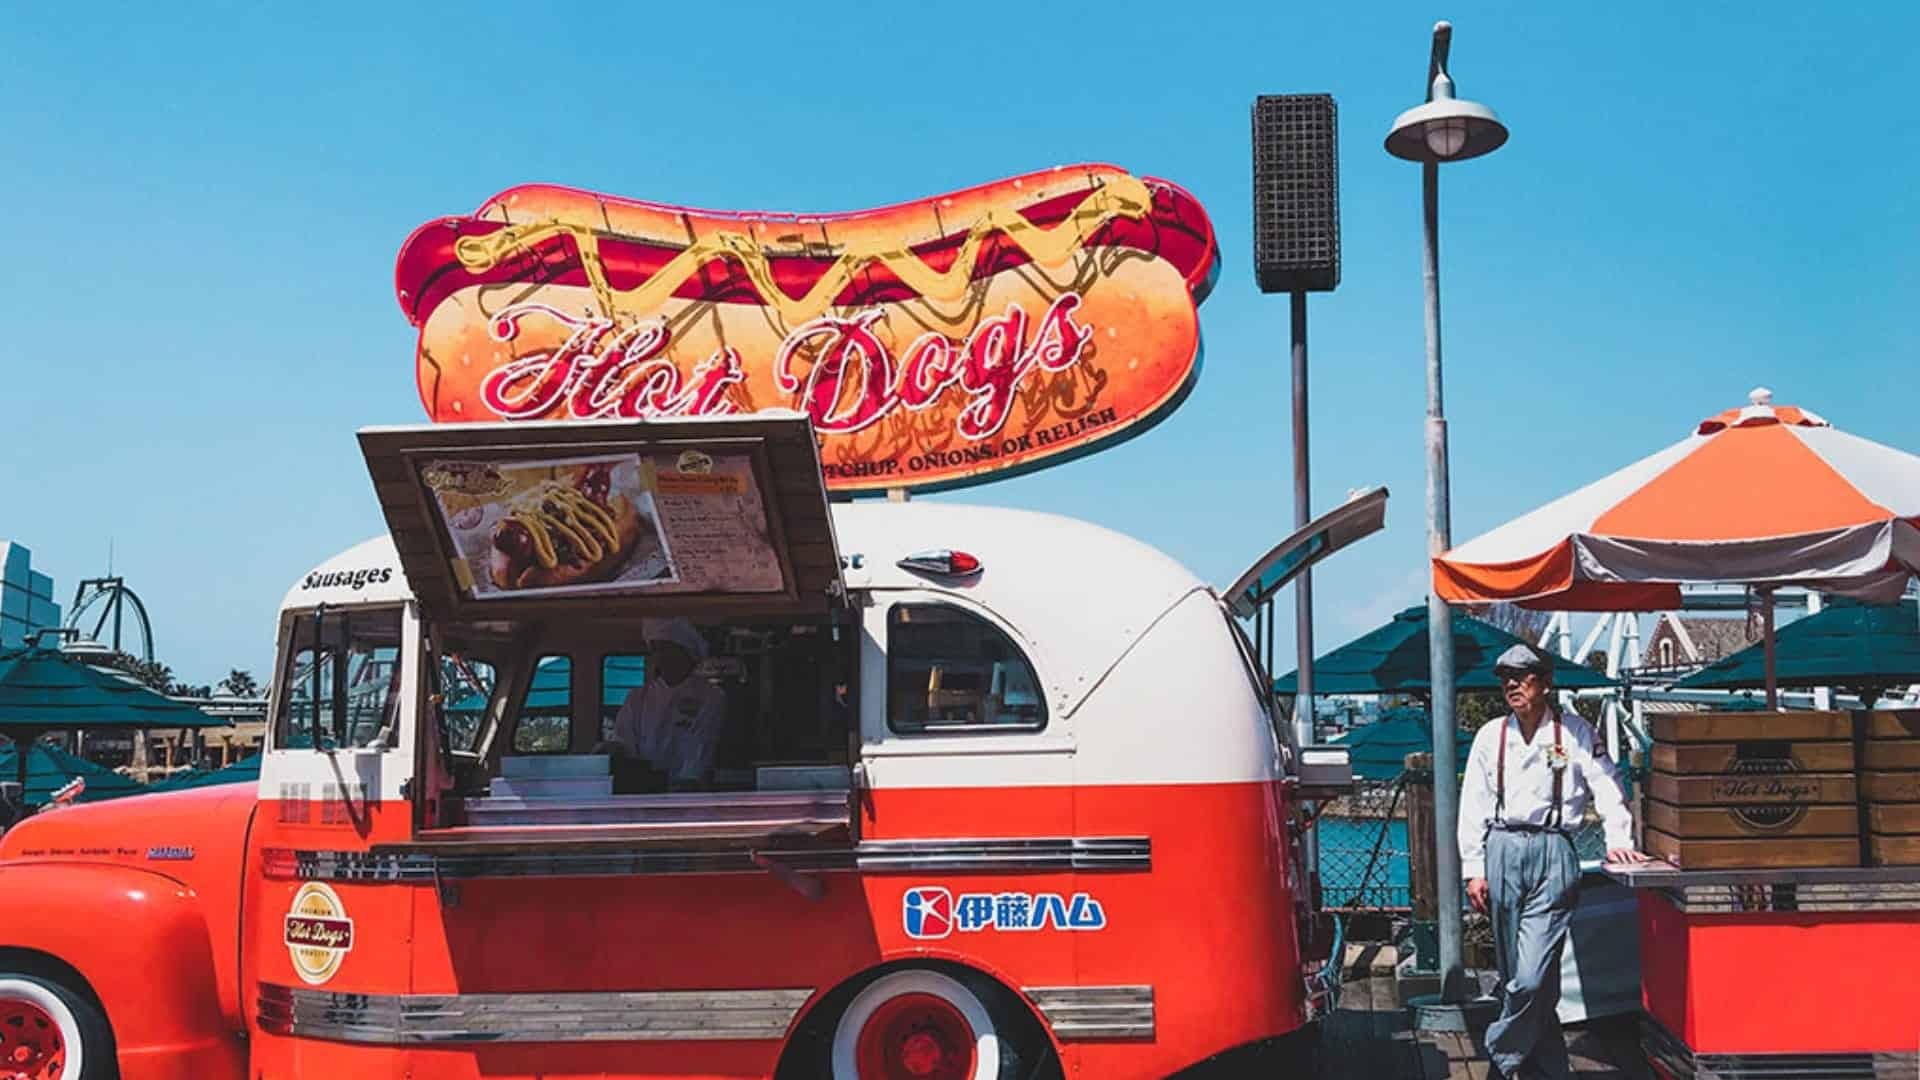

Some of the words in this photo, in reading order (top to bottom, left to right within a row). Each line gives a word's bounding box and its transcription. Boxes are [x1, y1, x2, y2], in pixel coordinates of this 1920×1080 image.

[481, 302, 745, 420] Hot
[778, 292, 1093, 441] Dogs
[822, 458, 904, 479] TCHUP,
[1002, 433, 1033, 455] OR
[1036, 407, 1118, 447] RELISH
[302, 567, 393, 591] Sausages
[1763, 780, 1810, 799] Dogs
[956, 894, 1105, 930] 伊藤ハム
[289, 920, 312, 938] Hot
[311, 922, 345, 947] Dogs
